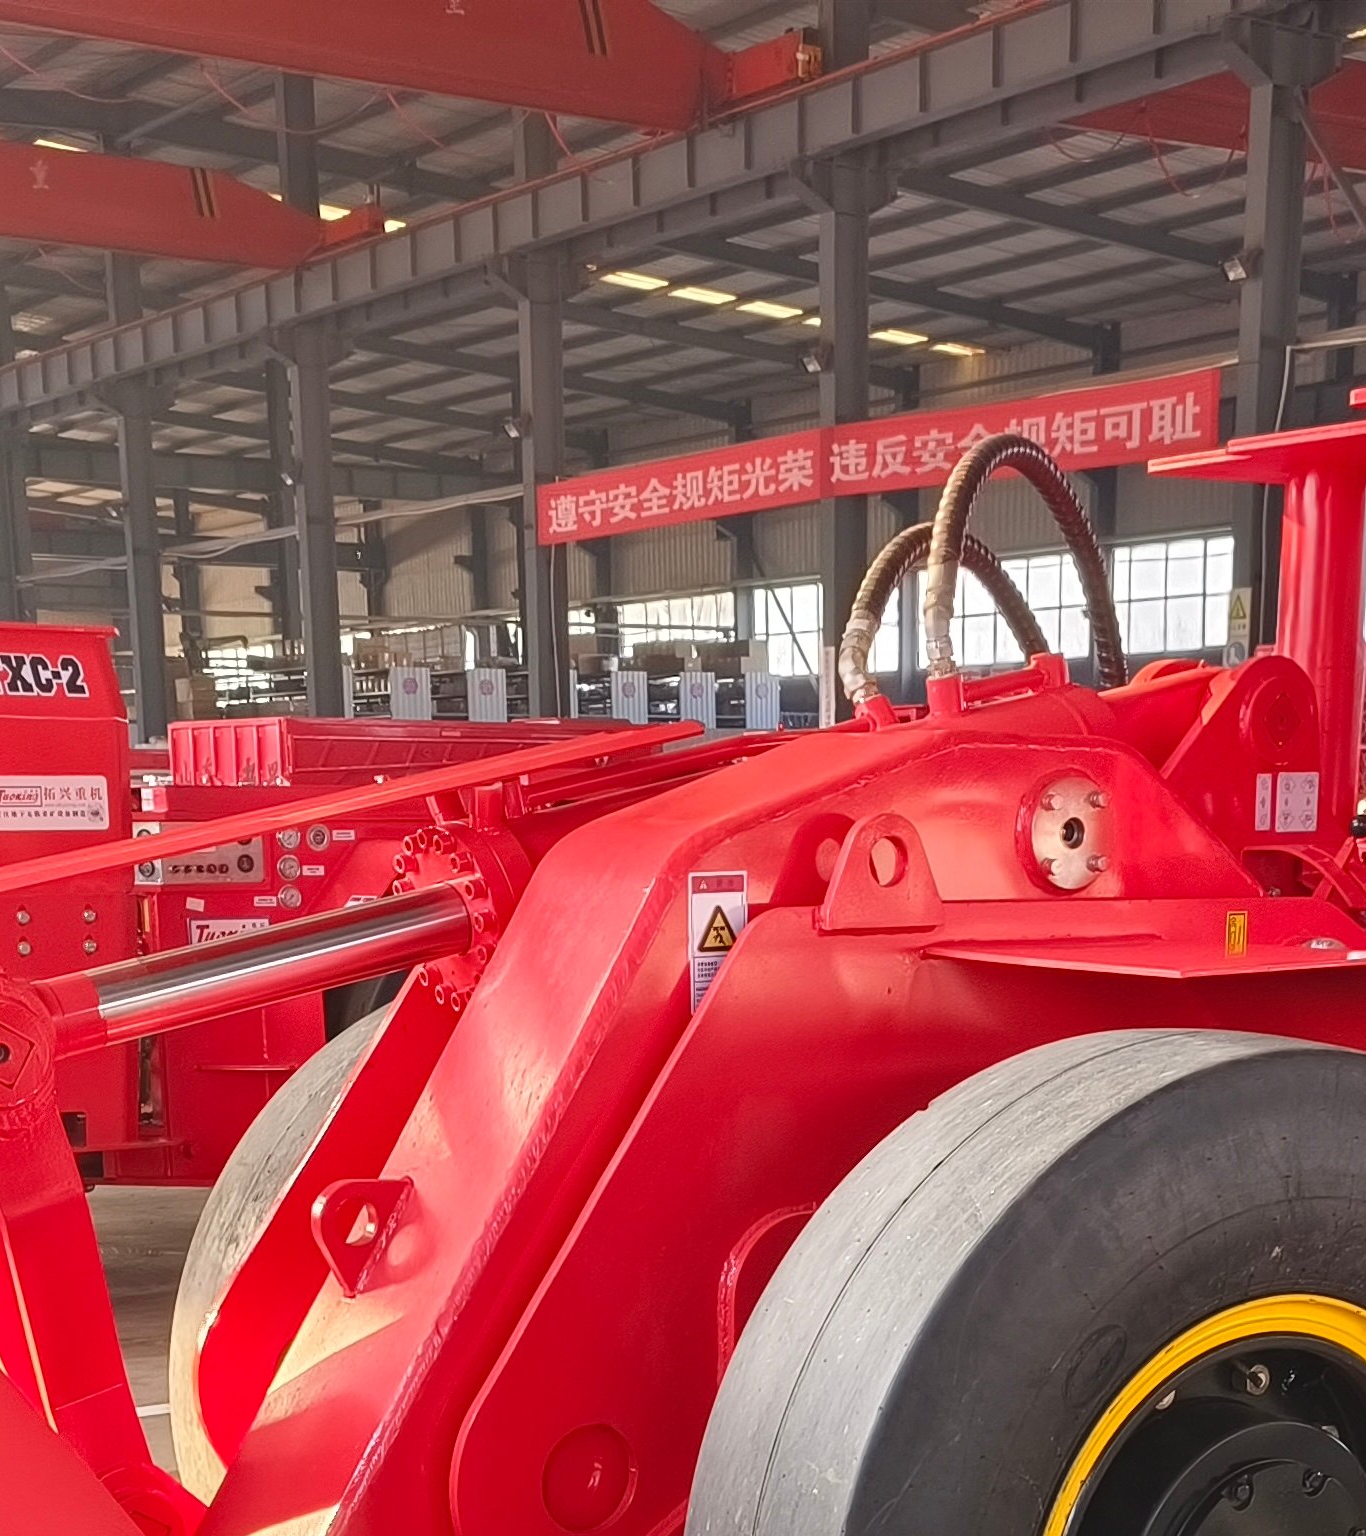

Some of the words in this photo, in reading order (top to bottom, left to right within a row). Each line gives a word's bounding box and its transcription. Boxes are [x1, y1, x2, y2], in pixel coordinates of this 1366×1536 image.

[548, 448, 816, 534] 遵守安全规矩光荣
